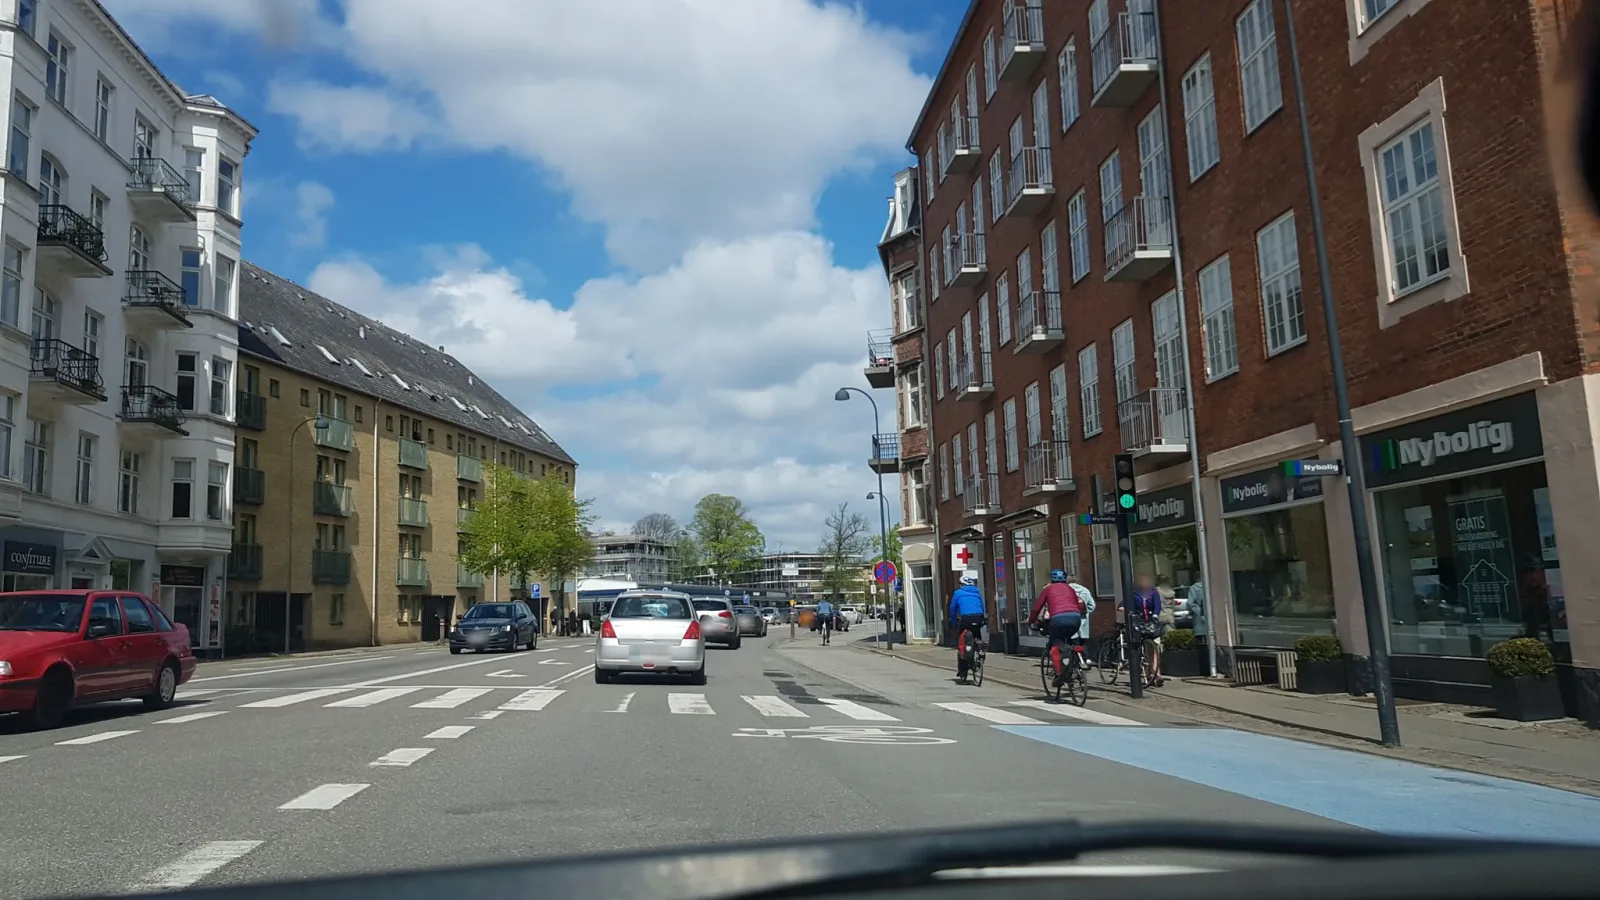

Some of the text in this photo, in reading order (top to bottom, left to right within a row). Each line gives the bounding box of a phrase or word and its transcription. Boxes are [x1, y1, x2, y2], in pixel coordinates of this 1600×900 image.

[1399, 420, 1515, 467] Nybolig
[1303, 463, 1339, 471] Nybolig
[1232, 482, 1268, 501] Nybolig
[1138, 497, 1185, 523] Nybolig
[1455, 515, 1485, 531] GRATIS
[533, 584, 539, 592] P
